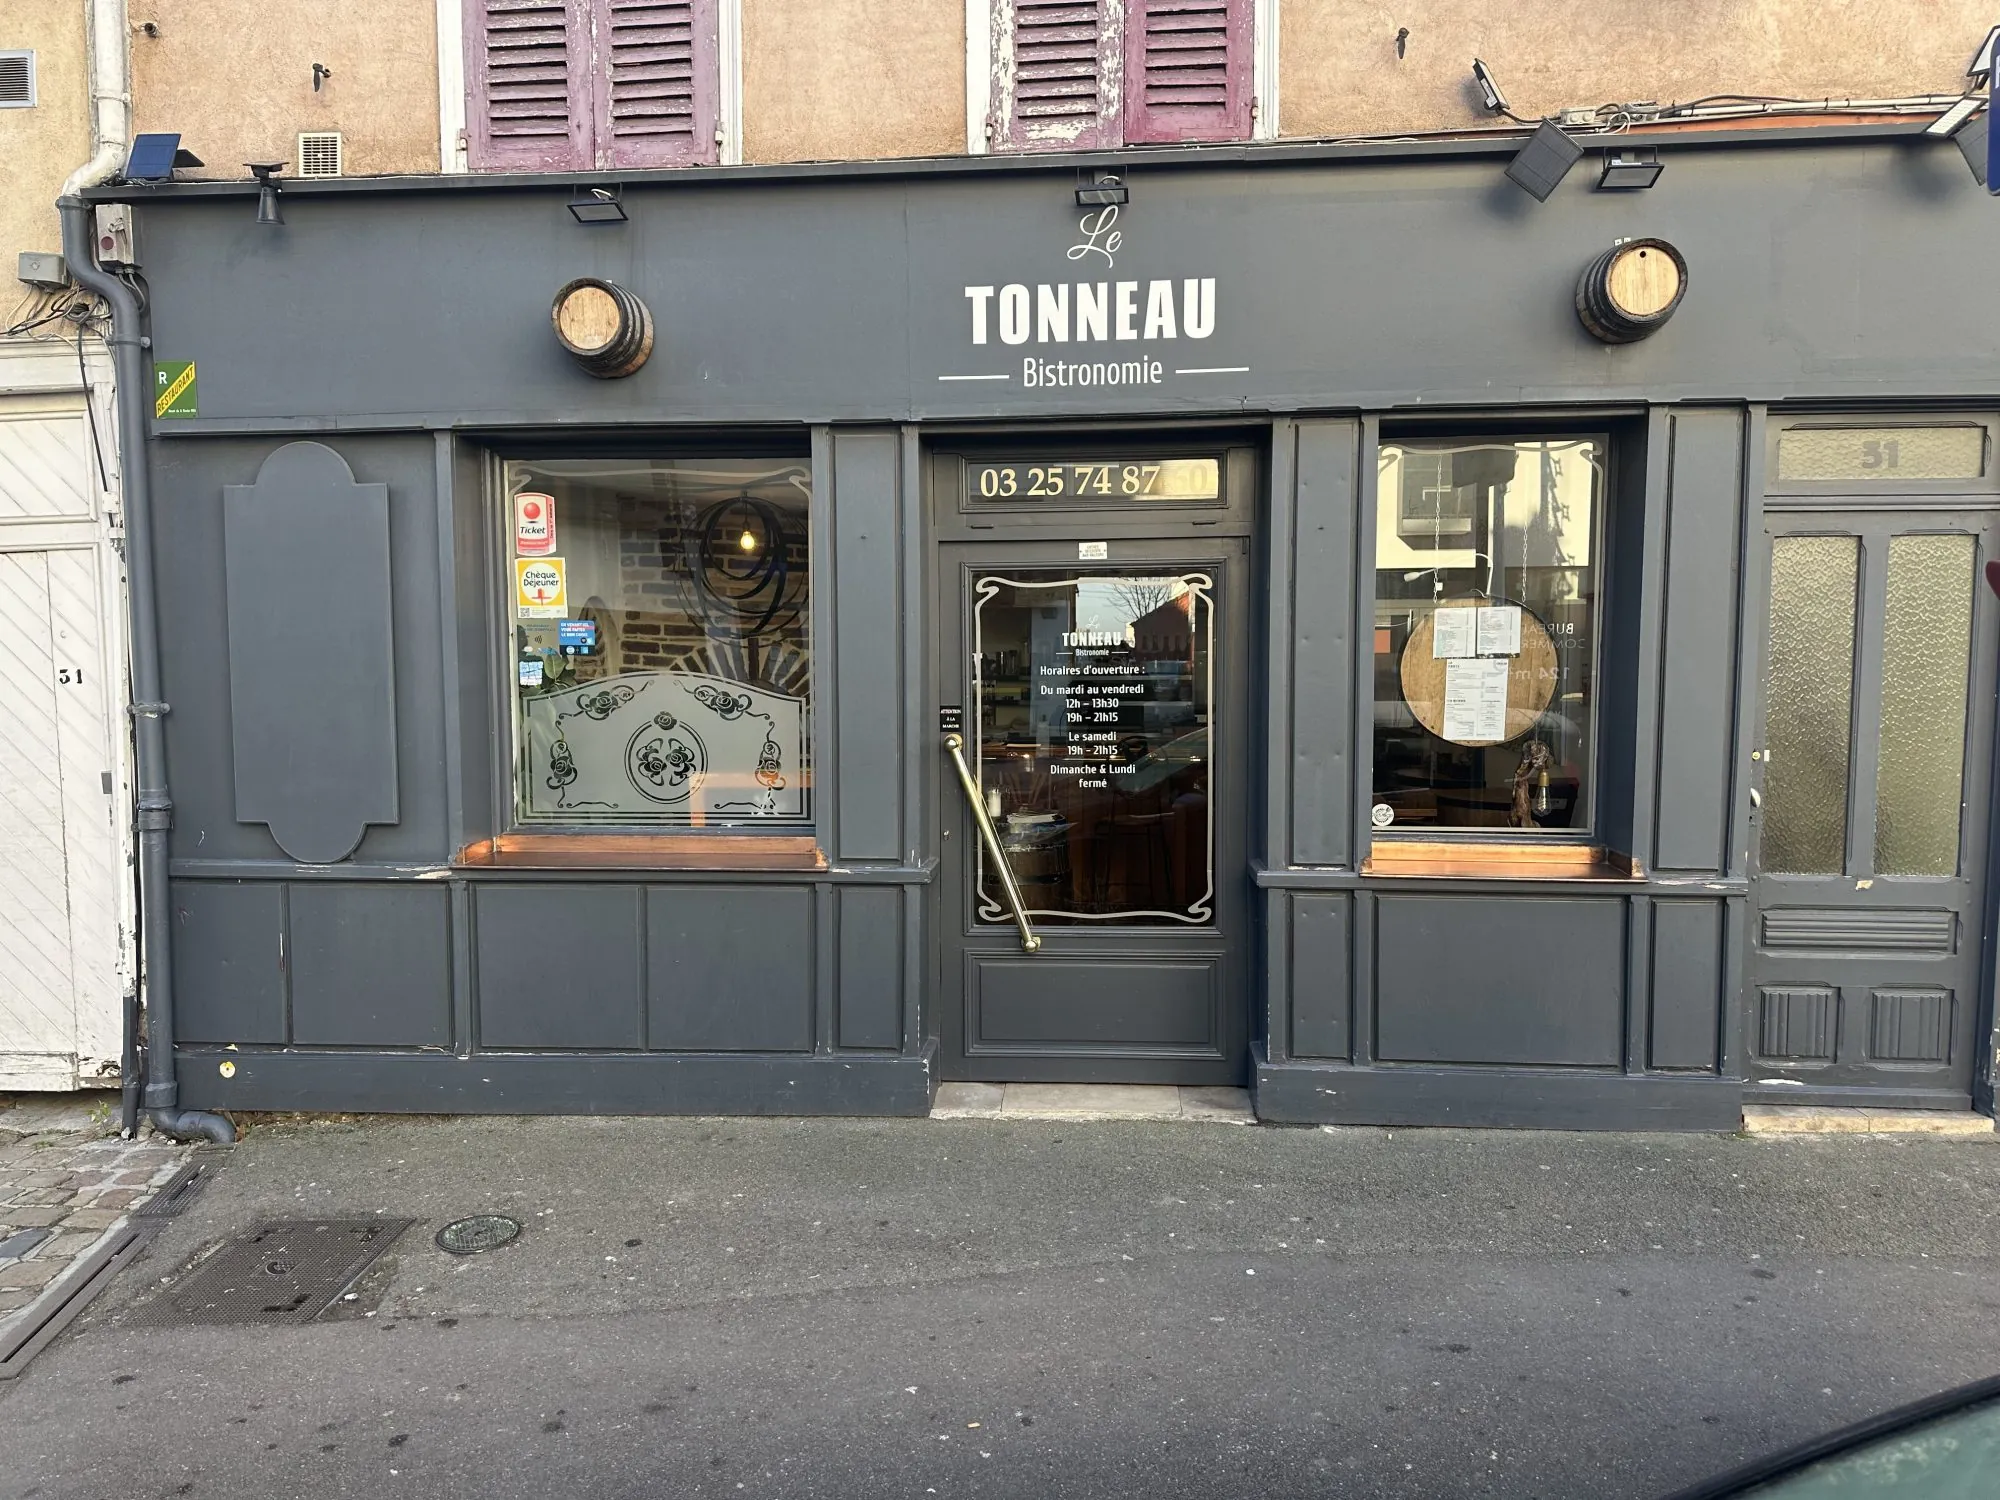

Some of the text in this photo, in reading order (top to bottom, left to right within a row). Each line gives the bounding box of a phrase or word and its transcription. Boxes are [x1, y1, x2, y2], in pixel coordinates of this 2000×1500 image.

[1066, 205, 1122, 269] Le
[964, 277, 1216, 345] TONNEAU
[1023, 355, 1163, 387] Bistronomie
[158, 371, 168, 385] R
[157, 366, 194, 415] RESTAURANT
[1863, 440, 1899, 469] 31
[980, 468, 1017, 497] 03
[1027, 468, 1064, 496] 25
[1074, 467, 1112, 495] 74
[1121, 465, 1161, 494] 87
[520, 526, 546, 534] Ticket
[525, 571, 556, 580] Chèque
[1062, 632, 1122, 647] TONNEAU
[1075, 648, 1109, 656] Bistronomie
[1040, 666, 1081, 675] Horaires
[1083, 665, 1140, 675] d'ouverture
[1040, 684, 1144, 695] Du mardi au vendredi
[1065, 699, 1081, 709] 12h
[1092, 698, 1119, 709] 13h30
[1067, 713, 1082, 722] 19h
[1093, 712, 1118, 722] 21h15
[1068, 731, 1117, 741] Le samedi
[1068, 745, 1083, 755] 19h
[1093, 745, 1118, 755] 21h15
[1050, 764, 1136, 774] Dimanche & Lundi
[1078, 778, 1108, 788] fermé
